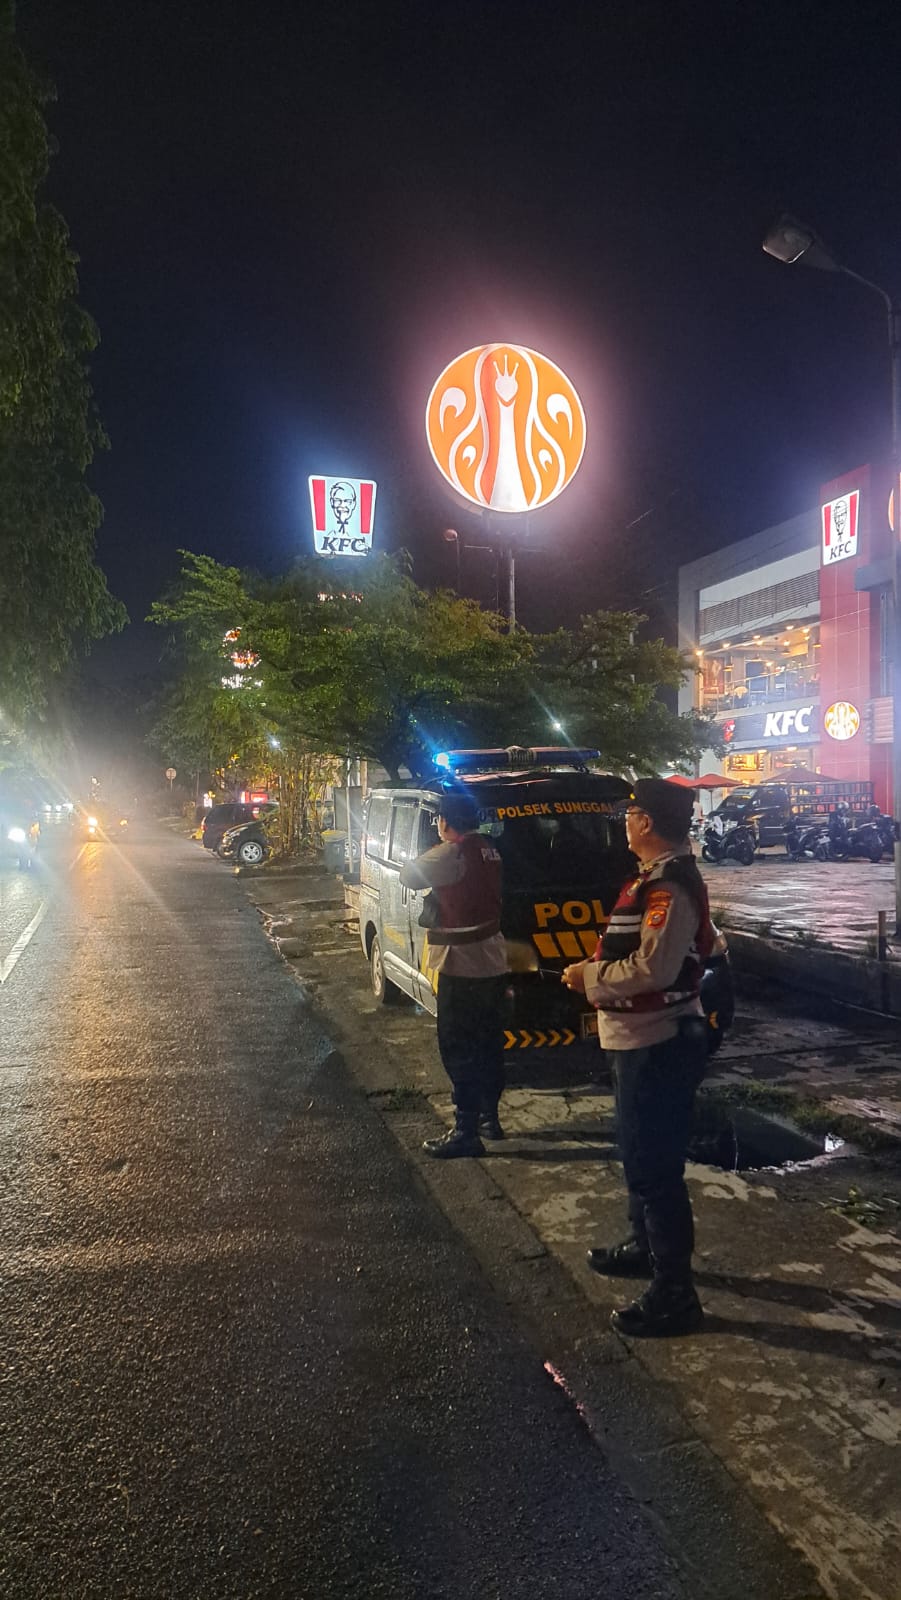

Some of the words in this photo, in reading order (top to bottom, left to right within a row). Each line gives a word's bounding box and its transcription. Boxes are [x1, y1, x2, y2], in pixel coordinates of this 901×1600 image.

[321, 536, 368, 552] KFC
[829, 540, 851, 560] KFC
[763, 706, 813, 737] KFC
[497, 802, 552, 819] POLSEK
